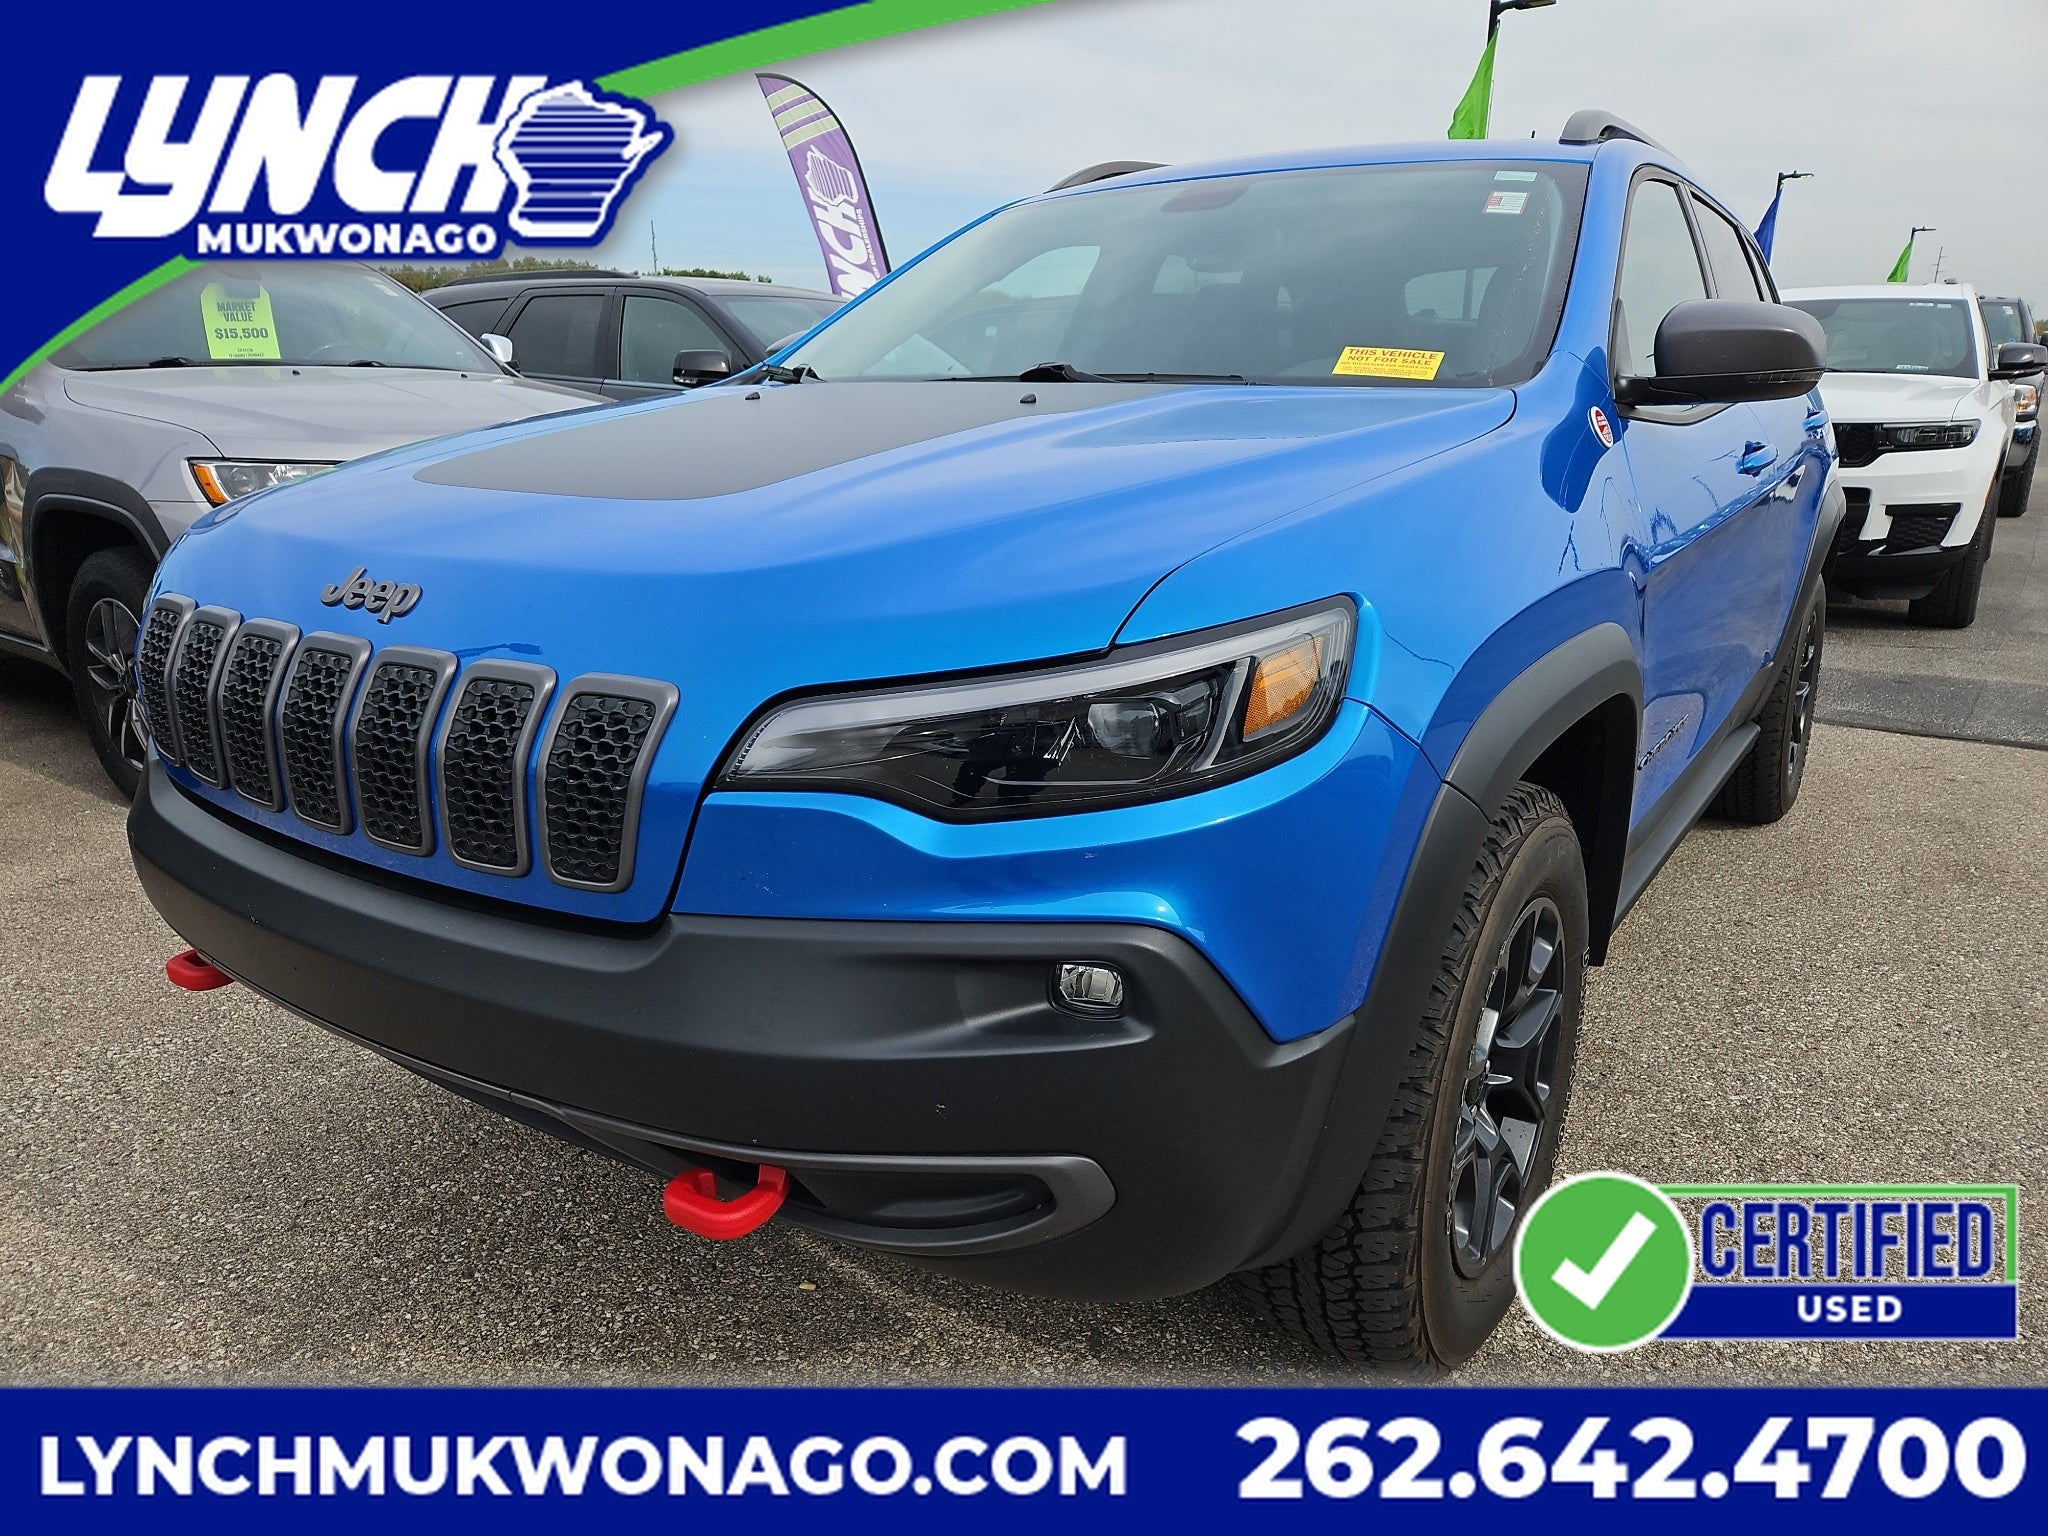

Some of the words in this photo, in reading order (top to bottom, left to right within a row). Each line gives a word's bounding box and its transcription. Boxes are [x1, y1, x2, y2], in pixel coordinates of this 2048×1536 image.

[807, 187, 877, 299] NCH
[855, 208, 877, 266] DEALERSHIPS
[216, 301, 256, 312] MARKET
[222, 312, 254, 322] VALUE
[214, 327, 269, 340] $15,500
[1348, 348, 1377, 356] THIS
[1381, 349, 1439, 360] VEHICLE
[1401, 358, 1433, 366] SALE
[320, 565, 423, 625] Jeep
